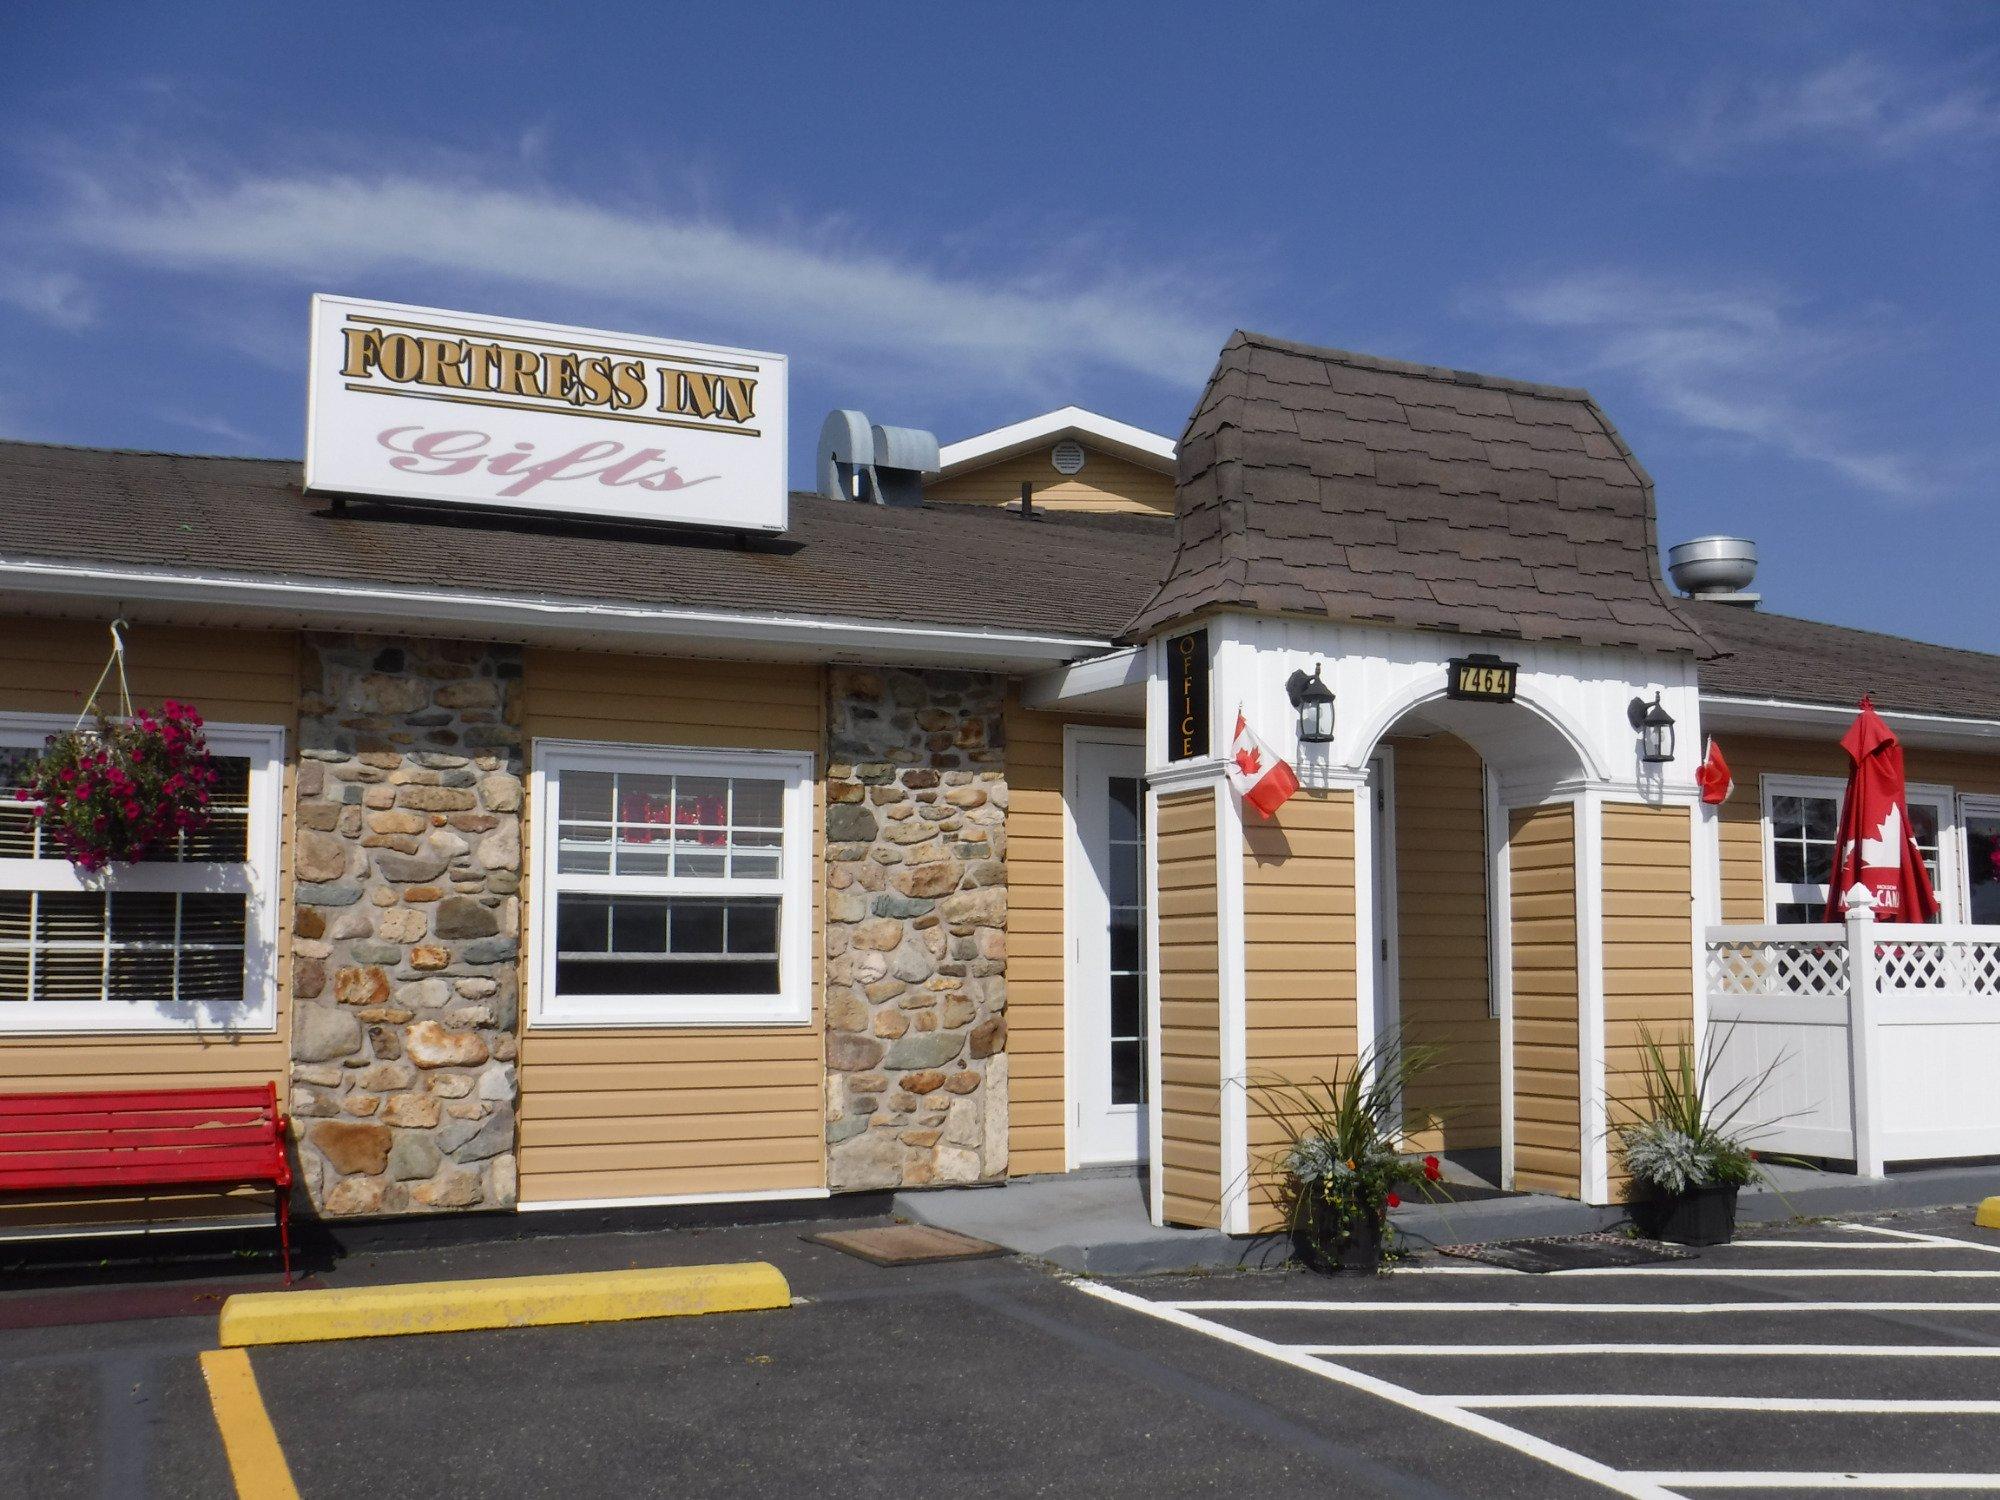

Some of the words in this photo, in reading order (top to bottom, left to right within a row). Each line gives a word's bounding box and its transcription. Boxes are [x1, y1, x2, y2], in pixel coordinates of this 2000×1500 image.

[339, 328, 648, 410] FORTRESS
[657, 366, 757, 423] INN
[377, 425, 721, 497] Gifts
[1180, 636, 1195, 756] OFFICE
[1462, 667, 1506, 693] 7464
